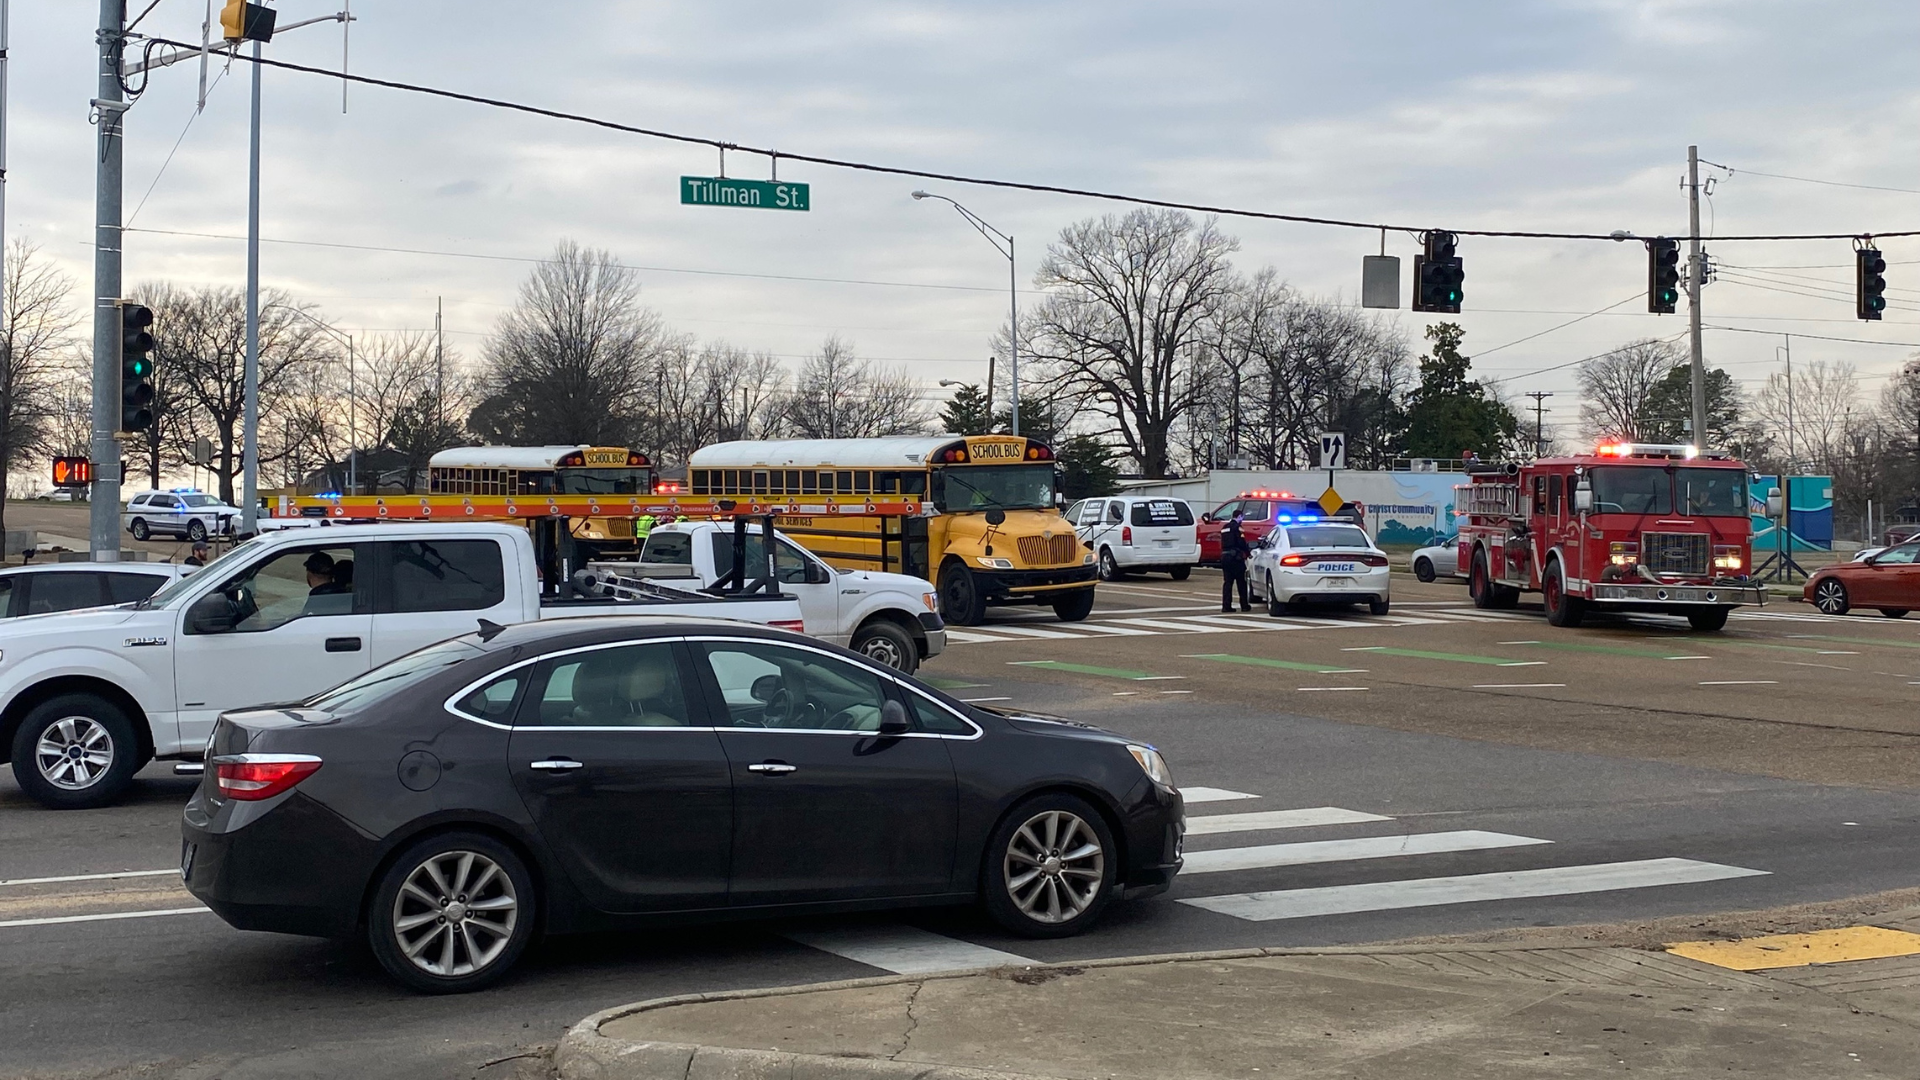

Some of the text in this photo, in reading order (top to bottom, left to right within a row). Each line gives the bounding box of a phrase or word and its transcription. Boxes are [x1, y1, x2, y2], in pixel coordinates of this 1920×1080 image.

[688, 180, 804, 208] Tillman St.
[972, 443, 1020, 459] SCHOOL BUS
[587, 453, 625, 464] SCHOOL BUS
[74, 463, 87, 481] 11
[1368, 503, 1435, 515] Christ Community
[786, 516, 813, 527] SERVICES
[1317, 563, 1355, 571] POLICE
